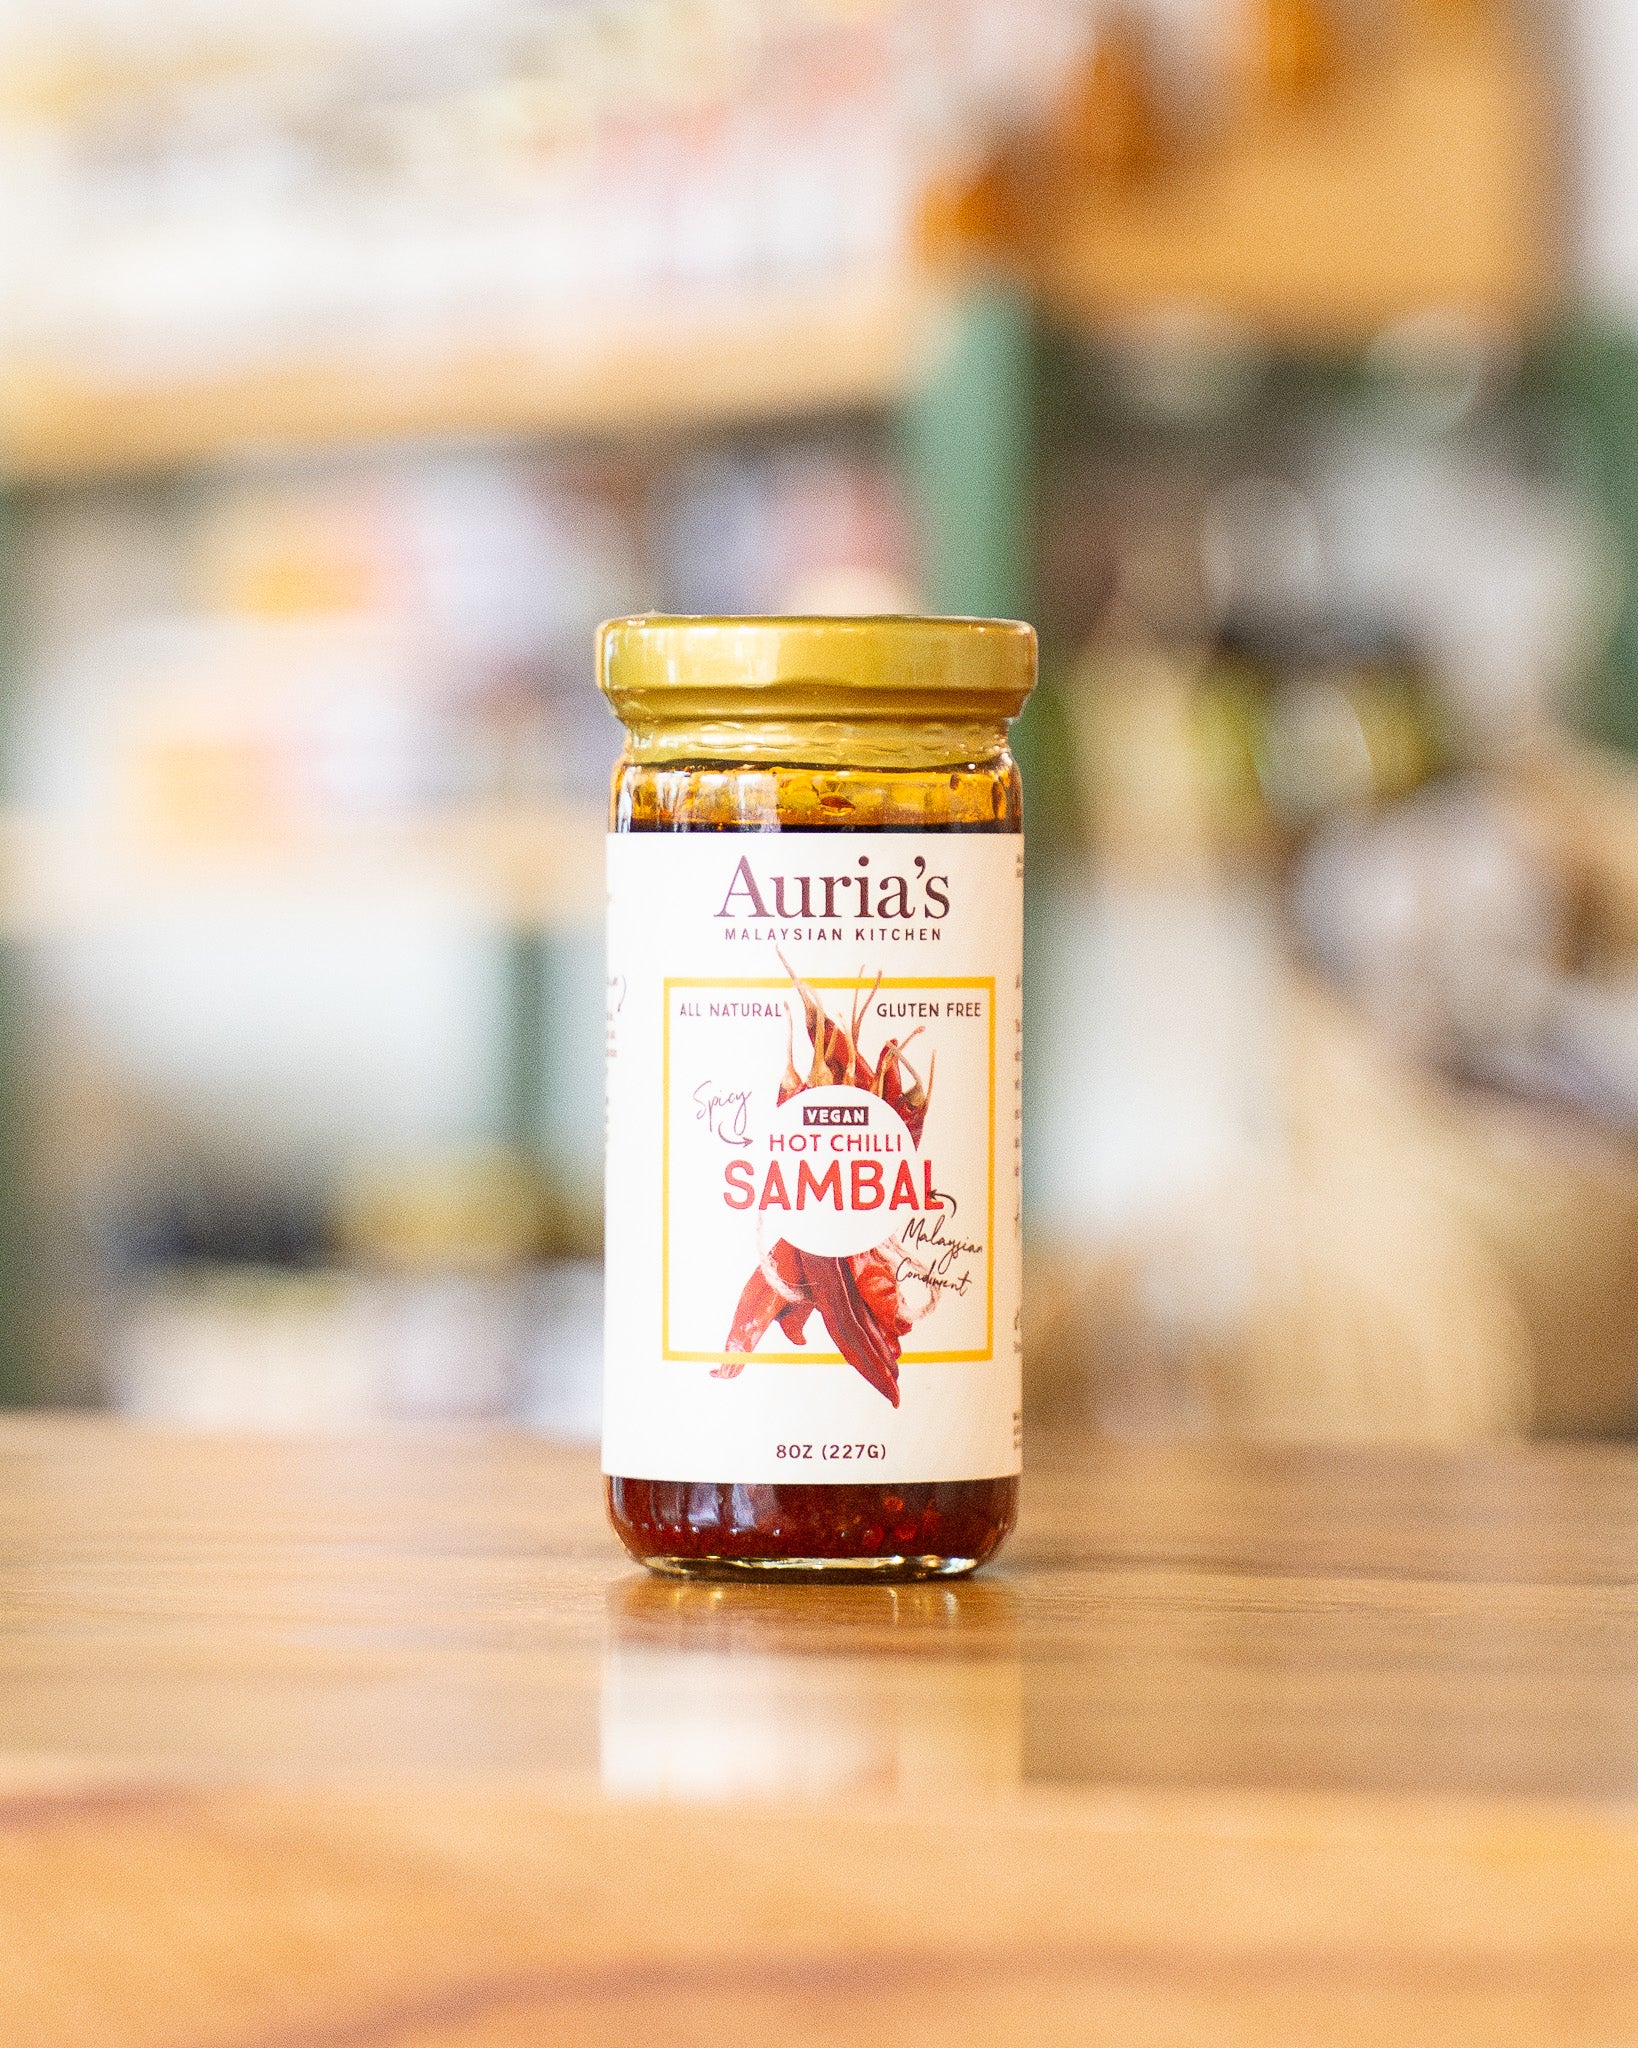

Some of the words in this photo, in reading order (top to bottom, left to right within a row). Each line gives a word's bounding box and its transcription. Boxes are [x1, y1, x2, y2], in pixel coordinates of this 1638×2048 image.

[713, 855, 951, 920] Auria's
[725, 928, 842, 941] MALAYSIAN
[856, 928, 942, 941] KITCHEN
[680, 1003, 702, 1017] ALL
[710, 1003, 782, 1017] NATURAL
[876, 1003, 940, 1017] GLUTEN
[947, 1003, 982, 1017] FREE
[693, 1080, 752, 1134] Spicy
[807, 1109, 866, 1124] VEGAN
[769, 1134, 824, 1152] HOT
[830, 1134, 902, 1152] CHILLI
[723, 1159, 945, 1211] SAMBAL
[901, 1214, 983, 1274] Malaysian
[895, 1257, 972, 1296] Condiment
[822, 1444, 886, 1460] (227G)
